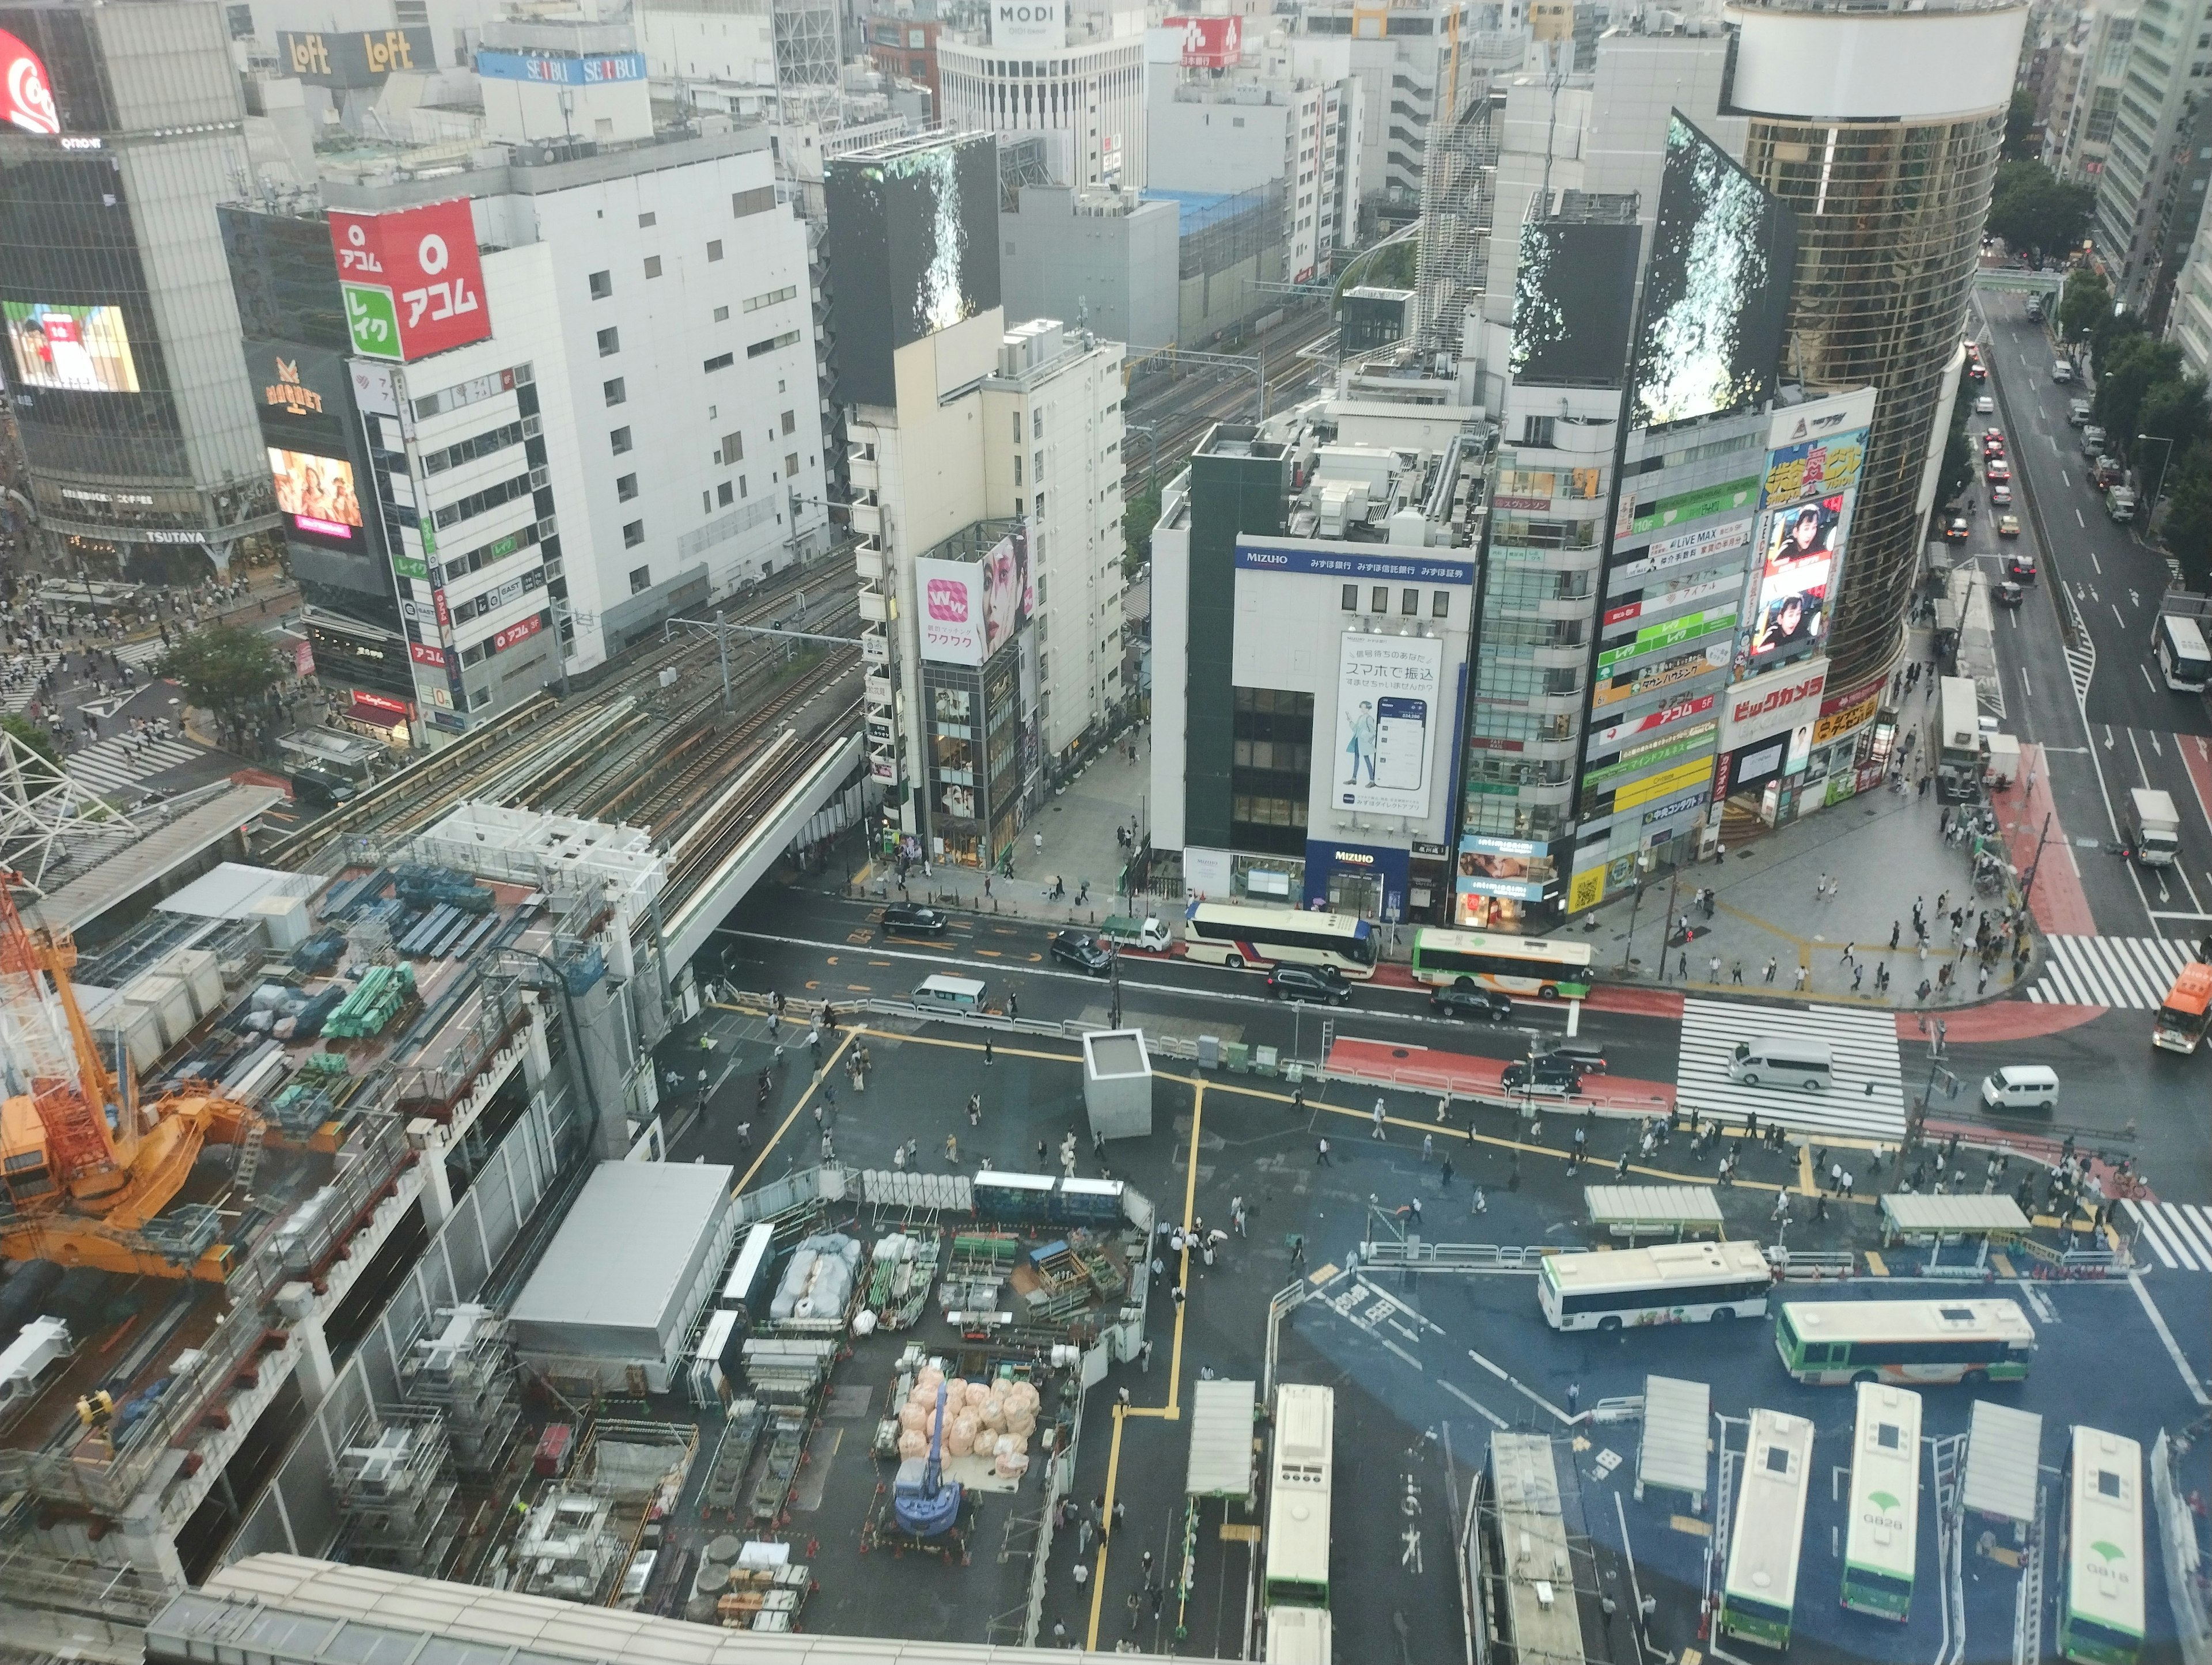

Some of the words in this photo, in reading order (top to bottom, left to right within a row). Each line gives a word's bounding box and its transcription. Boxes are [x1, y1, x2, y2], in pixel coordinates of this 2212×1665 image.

[1000, 6, 1054, 22] MODI
[526, 59, 569, 82] SEIBU
[583, 58, 638, 82] SEIBU
[340, 248, 383, 272] アコム
[403, 278, 478, 328] アコム
[146, 531, 206, 544] TSUTAYA
[1698, 529, 1717, 543] MAX
[398, 559, 427, 575] レイク
[1247, 552, 1288, 564] MIZUHO
[1310, 559, 1351, 570] みずほ銀行
[1357, 562, 1415, 575] みずほ信託銀行
[1421, 566, 1463, 578] みずほ証券
[507, 625, 529, 642] アコム
[928, 633, 972, 648] ワクワク
[1667, 630, 1687, 643] レイク
[415, 647, 445, 663] アコム
[1357, 650, 1426, 663] 信号待ちのあなた
[1615, 646, 1635, 659] レイク
[1346, 662, 1434, 681] スマホで振込
[1734, 676, 1824, 722] ビックカメラ
[1661, 703, 1692, 725] アコム
[1702, 696, 1713, 708] 5F
[1630, 744, 1685, 769] マインドフルネス
[1717, 755, 1729, 795] カラオケ
[1653, 799, 1697, 820] 中央コンタクト
[1335, 851, 1374, 863] MIZUHO
